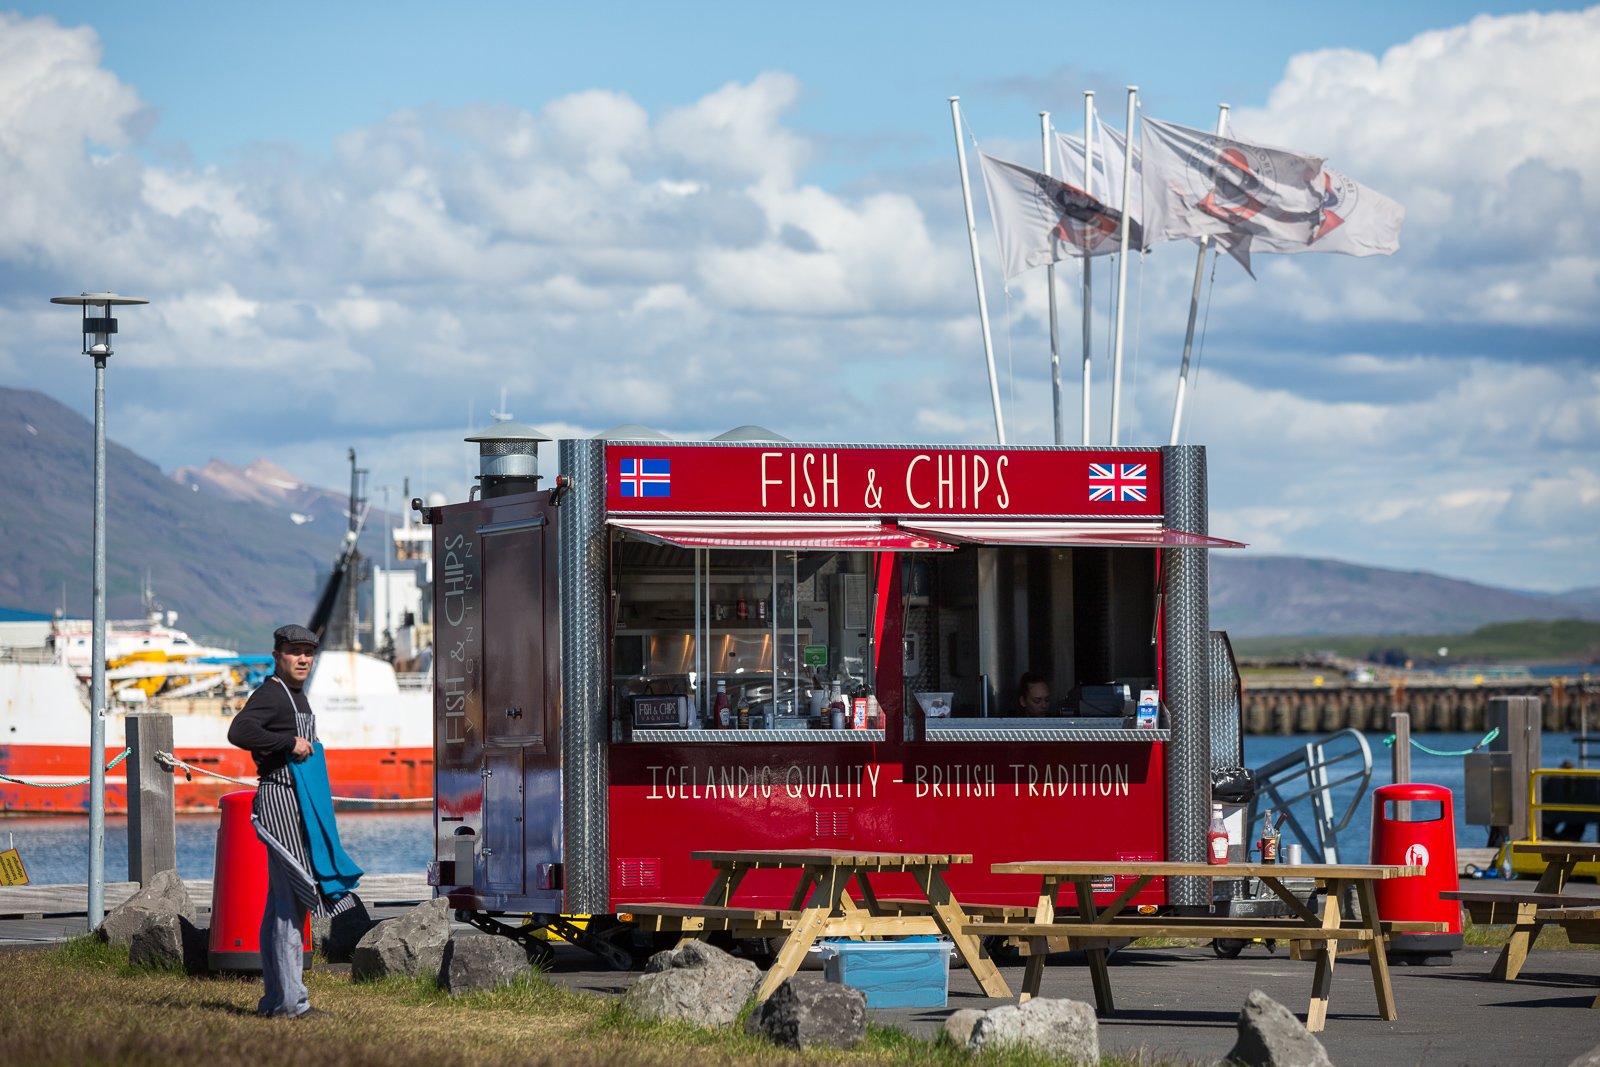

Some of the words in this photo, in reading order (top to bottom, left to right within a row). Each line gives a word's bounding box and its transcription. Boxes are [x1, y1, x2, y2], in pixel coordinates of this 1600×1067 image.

[761, 453, 839, 508] FISH
[864, 468, 883, 509] &
[906, 454, 1010, 509] CHIPS
[444, 534, 465, 626] CHIPS
[450, 641, 465, 662] &
[465, 542, 474, 733] VAGNINN
[445, 677, 465, 743] FISH
[639, 703, 652, 715] FISH
[660, 702, 676, 715] CHIPS
[646, 765, 771, 799] ICELANDIC
[786, 765, 880, 799] QUALITY
[915, 764, 995, 797] BRITISH
[1009, 763, 1129, 797] TRADITION
